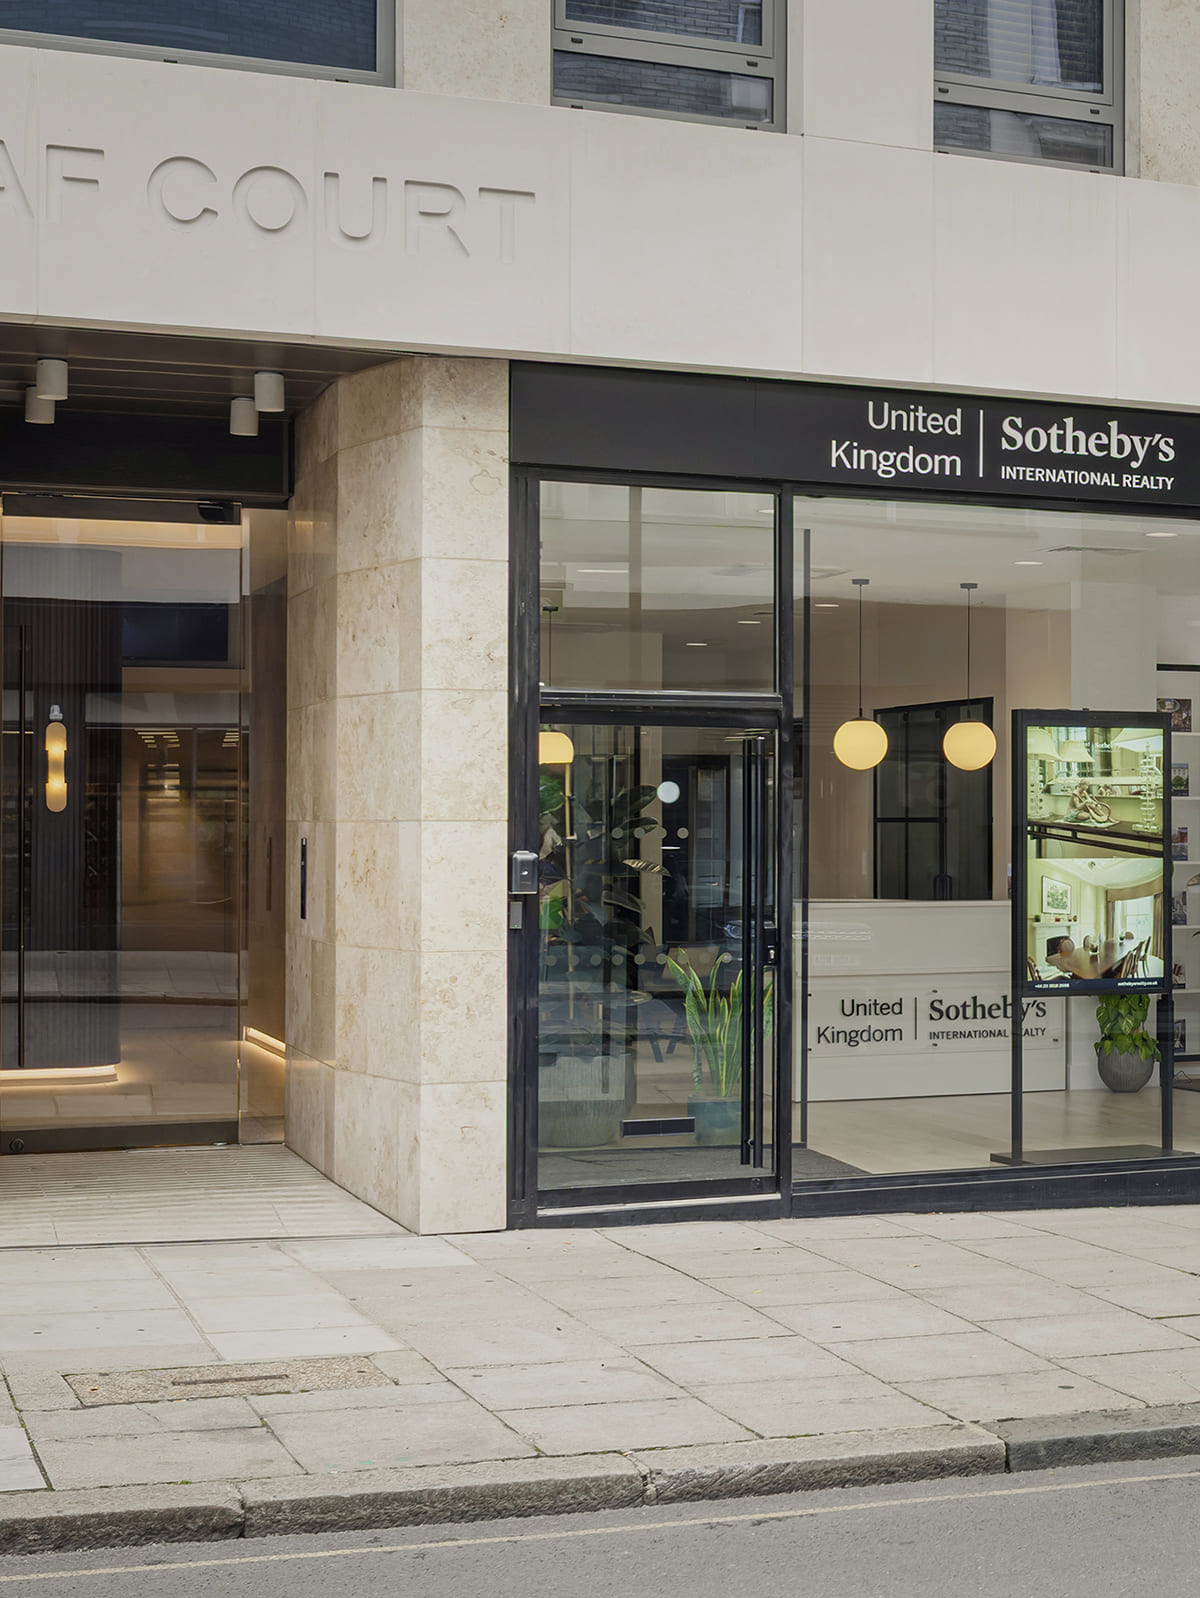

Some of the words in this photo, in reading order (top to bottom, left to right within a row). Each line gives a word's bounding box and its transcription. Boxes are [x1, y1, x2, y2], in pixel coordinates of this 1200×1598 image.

[146, 155, 537, 262] COURT
[868, 401, 962, 436] United
[1001, 416, 1176, 469] Sotheby's
[831, 440, 962, 479] Kingdom
[1001, 465, 1120, 488] INTERNATIONAL
[1122, 473, 1175, 491] REALTY
[841, 997, 903, 1017] United
[816, 1025, 903, 1048] Kingdom
[929, 1028, 1009, 1041] INTERNATIONAL
